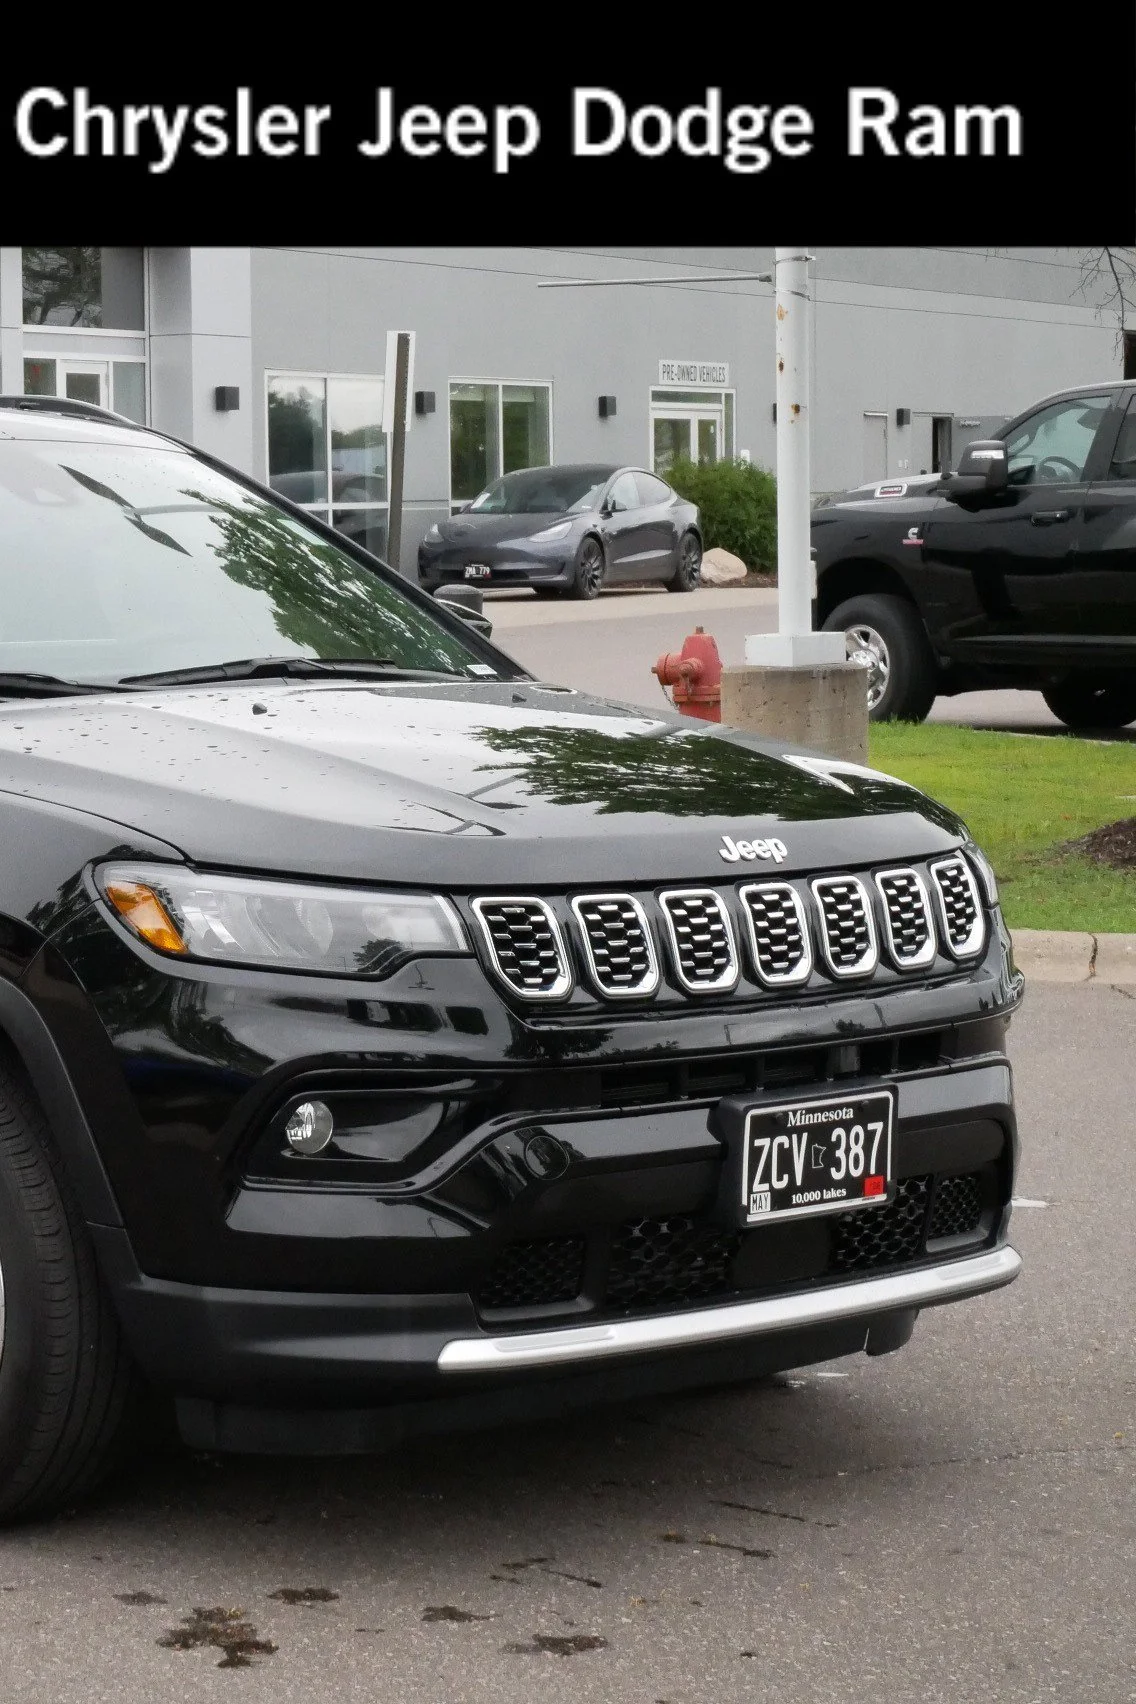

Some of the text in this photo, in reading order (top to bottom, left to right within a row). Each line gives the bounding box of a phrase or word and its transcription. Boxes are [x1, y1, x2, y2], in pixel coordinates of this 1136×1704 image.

[662, 364, 726, 383] PRE-OWNED VEHICLES
[719, 836, 788, 864] Jeep
[787, 1107, 854, 1128] Minnesota
[752, 1121, 884, 1193] ZCV 387
[752, 1194, 769, 1211] MAY
[791, 1187, 847, 1205] 10,000 lakes
